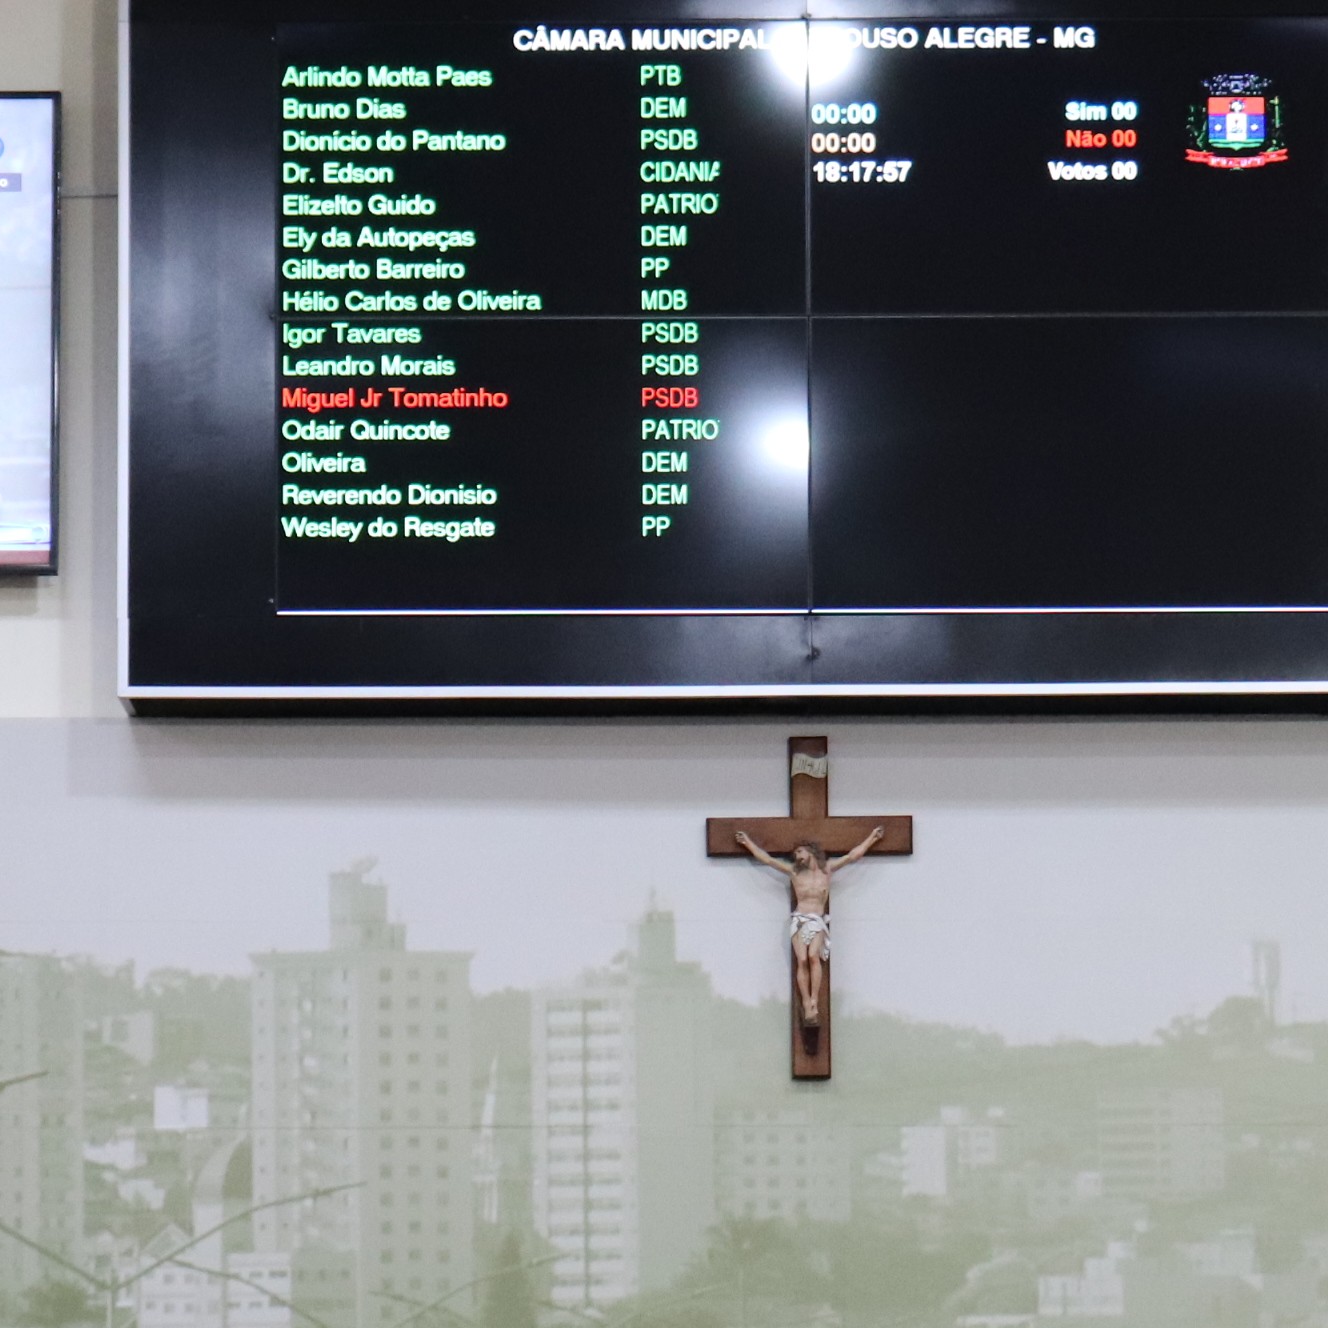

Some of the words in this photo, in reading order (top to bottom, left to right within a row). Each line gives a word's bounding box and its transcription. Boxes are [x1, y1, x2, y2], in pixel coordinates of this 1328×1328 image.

[512, 25, 626, 51] CÂMARA
[631, 28, 771, 50] MUNICIPAL
[832, 26, 920, 49] OUSO
[923, 25, 1031, 49] ALEGRE
[1053, 25, 1096, 49] MG
[281, 65, 363, 88] Arlindo
[367, 65, 431, 87] Motta
[436, 64, 493, 87] Paes
[640, 64, 682, 87] PTB
[282, 97, 351, 120] Bruno
[356, 97, 407, 120] Dias
[640, 96, 687, 119] DEM
[811, 103, 877, 124] 00:00
[1065, 101, 1107, 121] Sim
[1111, 101, 1137, 121] 00
[282, 129, 373, 152] Dionício
[376, 129, 407, 152] do
[412, 129, 507, 151] Pantano
[640, 128, 699, 151] PSDB
[811, 132, 876, 154] 00:00
[1065, 129, 1107, 149] Não
[1112, 129, 1137, 148] 00
[282, 161, 316, 184] Dr.
[322, 161, 394, 184] Edson
[812, 160, 913, 183] 18:17:57
[1047, 160, 1109, 181] Votos
[1111, 160, 1138, 181] 00
[282, 193, 363, 216] Elizelto
[367, 193, 437, 216] Guido
[640, 192, 719, 215] PATRIO
[282, 226, 318, 253] Ely
[321, 226, 353, 248] da
[356, 225, 477, 253] Autopeças
[640, 224, 687, 247] DEM
[281, 258, 371, 280] Gilberto
[376, 257, 466, 280] Barreiro
[641, 257, 670, 279] PP
[282, 290, 340, 312] Hélio
[344, 290, 418, 312] Carlos
[422, 290, 452, 312] de
[457, 289, 542, 311] Oliveira
[641, 289, 688, 311] MDB
[282, 323, 327, 349] Igor
[331, 322, 422, 344] Tavares
[641, 321, 699, 344] PSDB
[282, 354, 376, 376] Leandro
[380, 354, 456, 376] Morais
[641, 354, 700, 376] PSDB
[282, 387, 356, 414] Miguel
[360, 387, 383, 409] Jr
[387, 387, 509, 409] Tomatinho
[641, 386, 699, 409] PSDB
[281, 419, 345, 441] Odair
[349, 418, 451, 441] Quincote
[641, 419, 720, 441] PATRIO
[281, 451, 367, 473] Oliveira
[641, 450, 689, 473] DEM
[282, 483, 402, 506] Reverendo
[408, 483, 498, 505] Dionisio
[641, 483, 689, 505] DEM
[280, 516, 364, 543] Wesley
[367, 516, 398, 538] do
[404, 515, 496, 543] Resgate
[642, 515, 671, 537] PP
